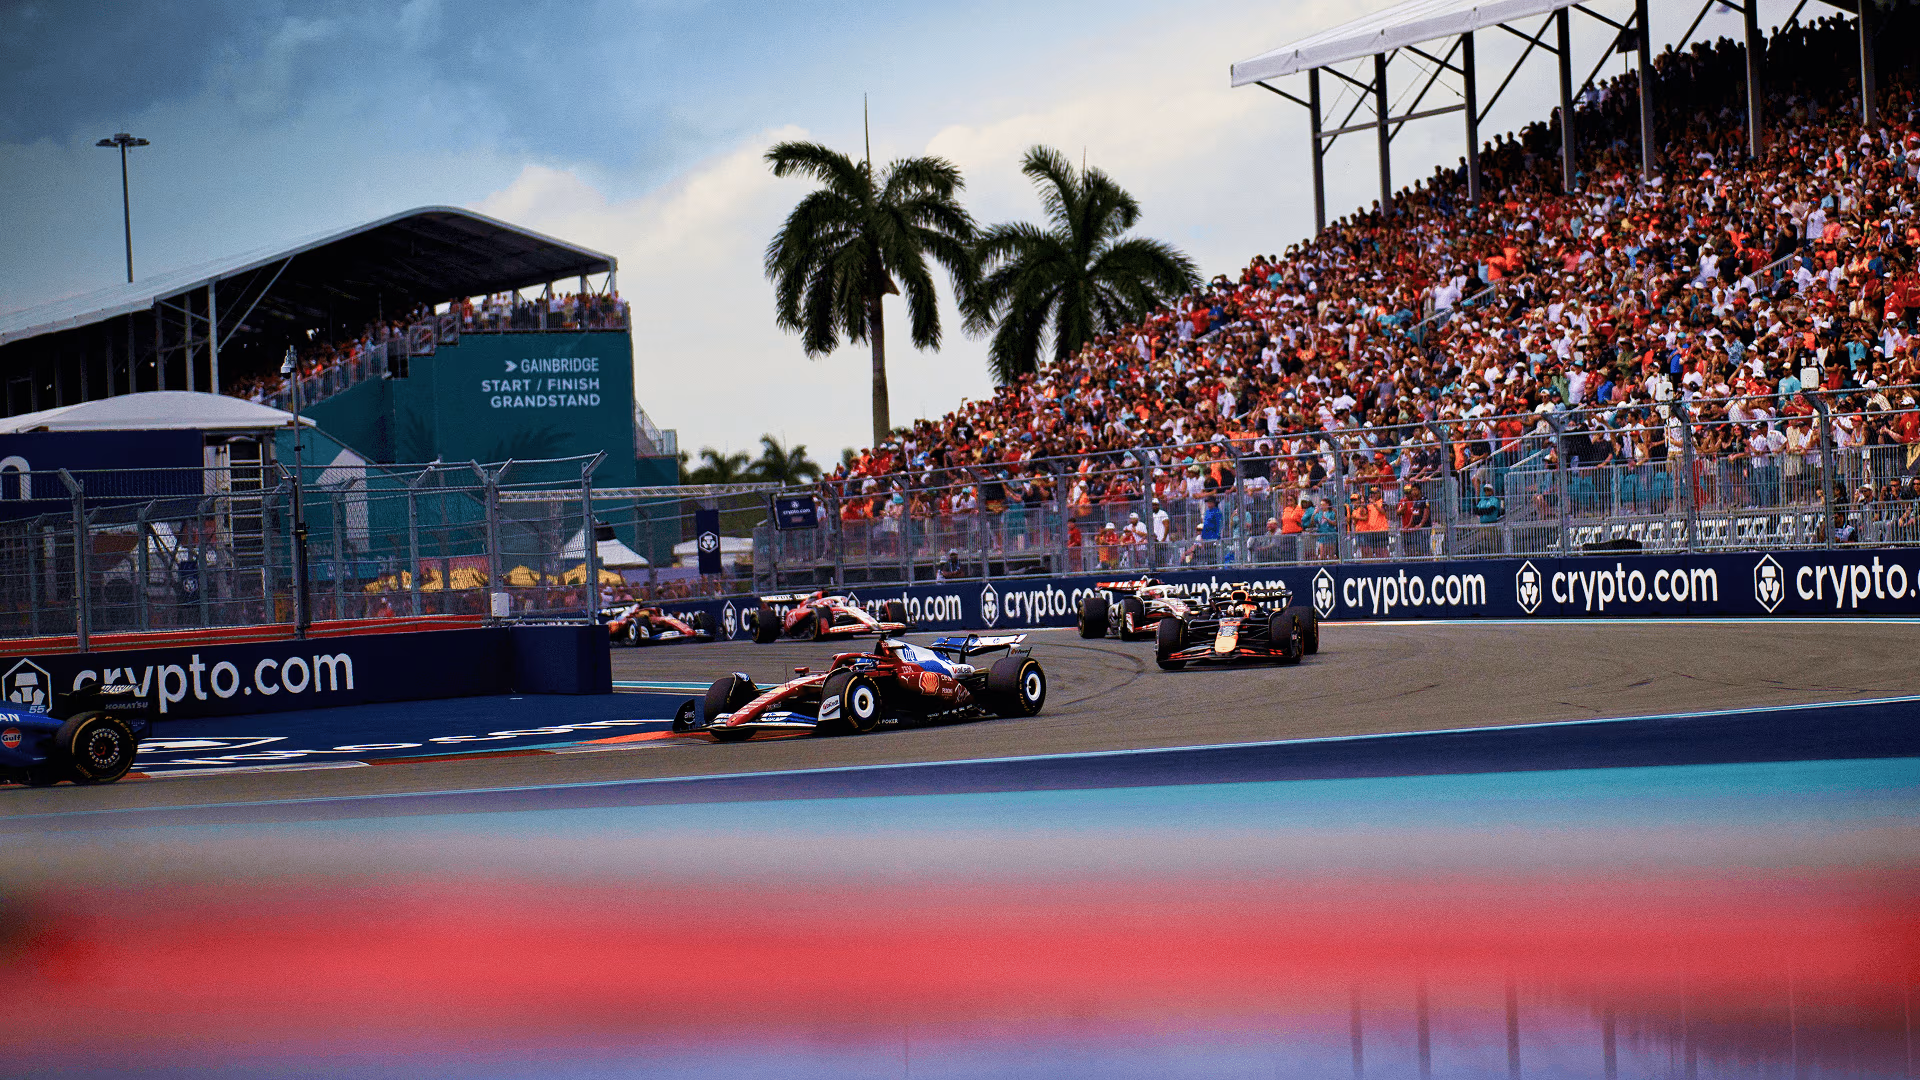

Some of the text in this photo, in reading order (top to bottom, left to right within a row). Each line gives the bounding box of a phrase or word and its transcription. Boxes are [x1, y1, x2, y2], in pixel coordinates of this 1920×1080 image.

[521, 357, 600, 373] GAINBRIDGE
[481, 377, 600, 392] START / FINISH
[490, 393, 601, 409] GRANDSTAND
[1551, 563, 1718, 612] crypto.com
[1796, 556, 1920, 609] crypto.
[1343, 569, 1486, 615] crypto.com
[866, 592, 962, 622] crto.com
[28, 705, 46, 714] 55
[104, 701, 149, 710] KOMATSU
[2, 734, 21, 742] Gulf
